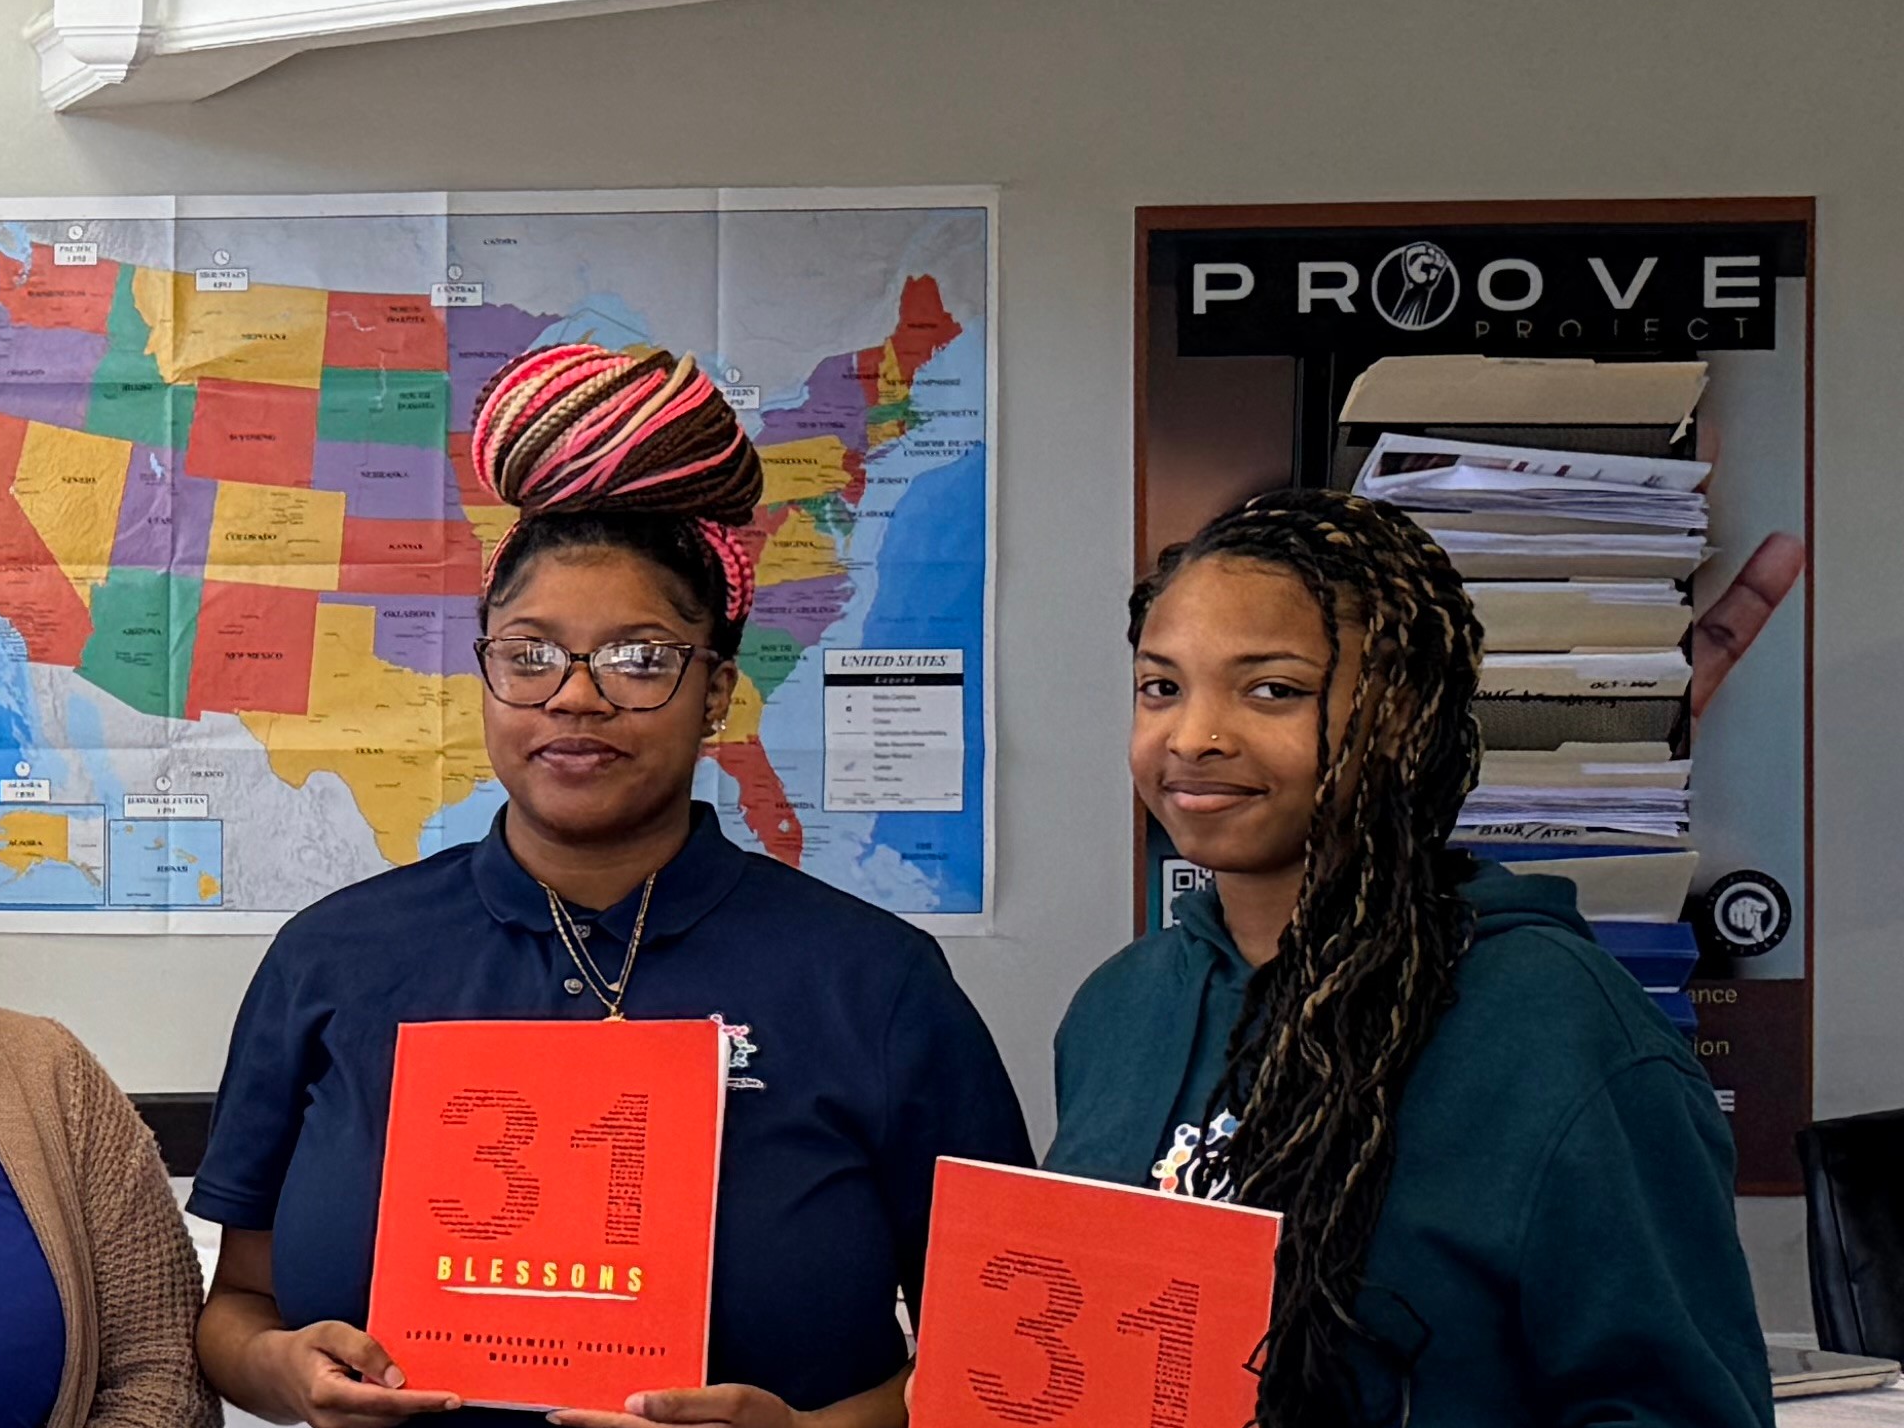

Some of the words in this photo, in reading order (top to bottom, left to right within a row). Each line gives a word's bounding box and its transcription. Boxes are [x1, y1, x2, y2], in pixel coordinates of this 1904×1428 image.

[841, 655, 894, 668] UNITED
[896, 654, 948, 667] STATES
[428, 1088, 649, 1246] 31
[437, 1256, 643, 1292] BLESSONS
